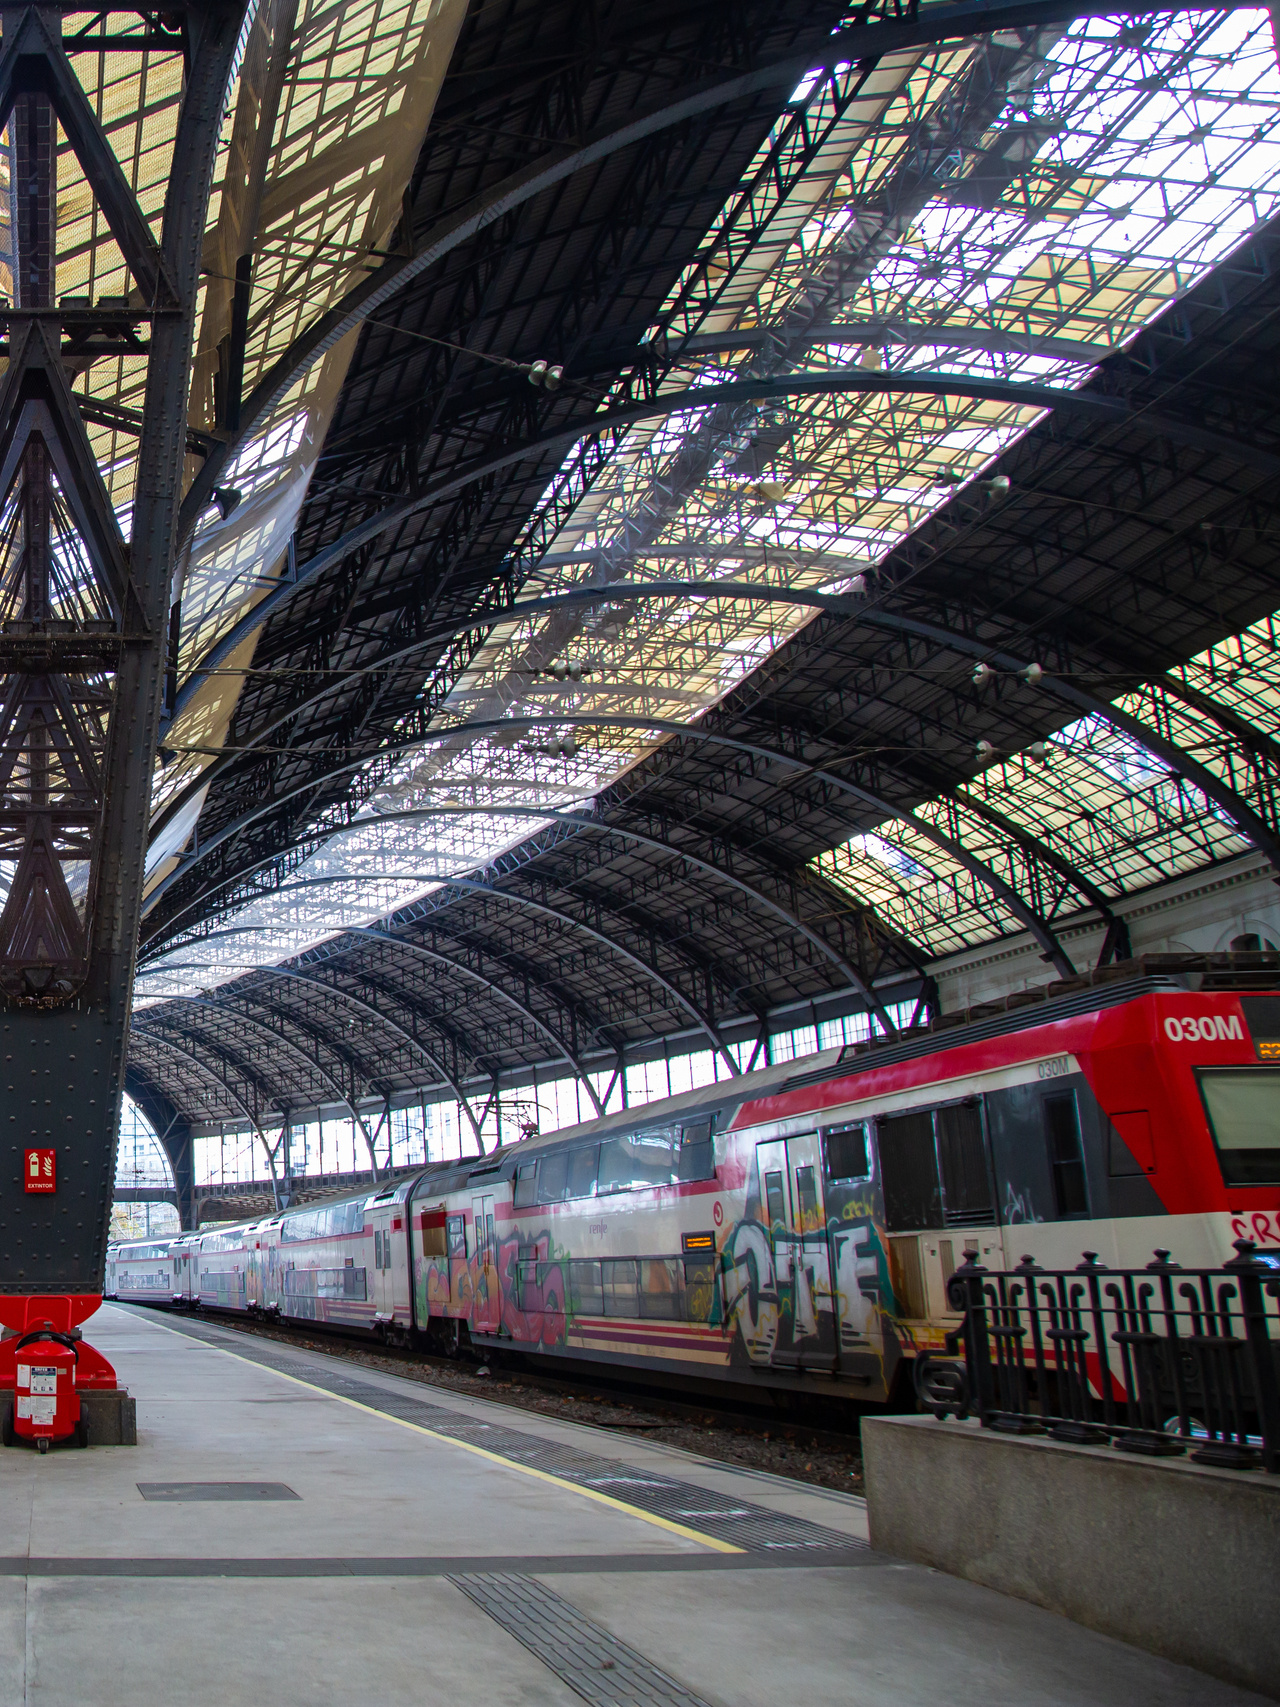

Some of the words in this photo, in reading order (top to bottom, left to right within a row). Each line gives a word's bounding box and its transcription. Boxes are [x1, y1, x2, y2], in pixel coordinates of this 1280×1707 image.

[1163, 1015, 1244, 1042] 030M
[1038, 1057, 1070, 1079] 030M
[589, 1218, 608, 1240] renfe
